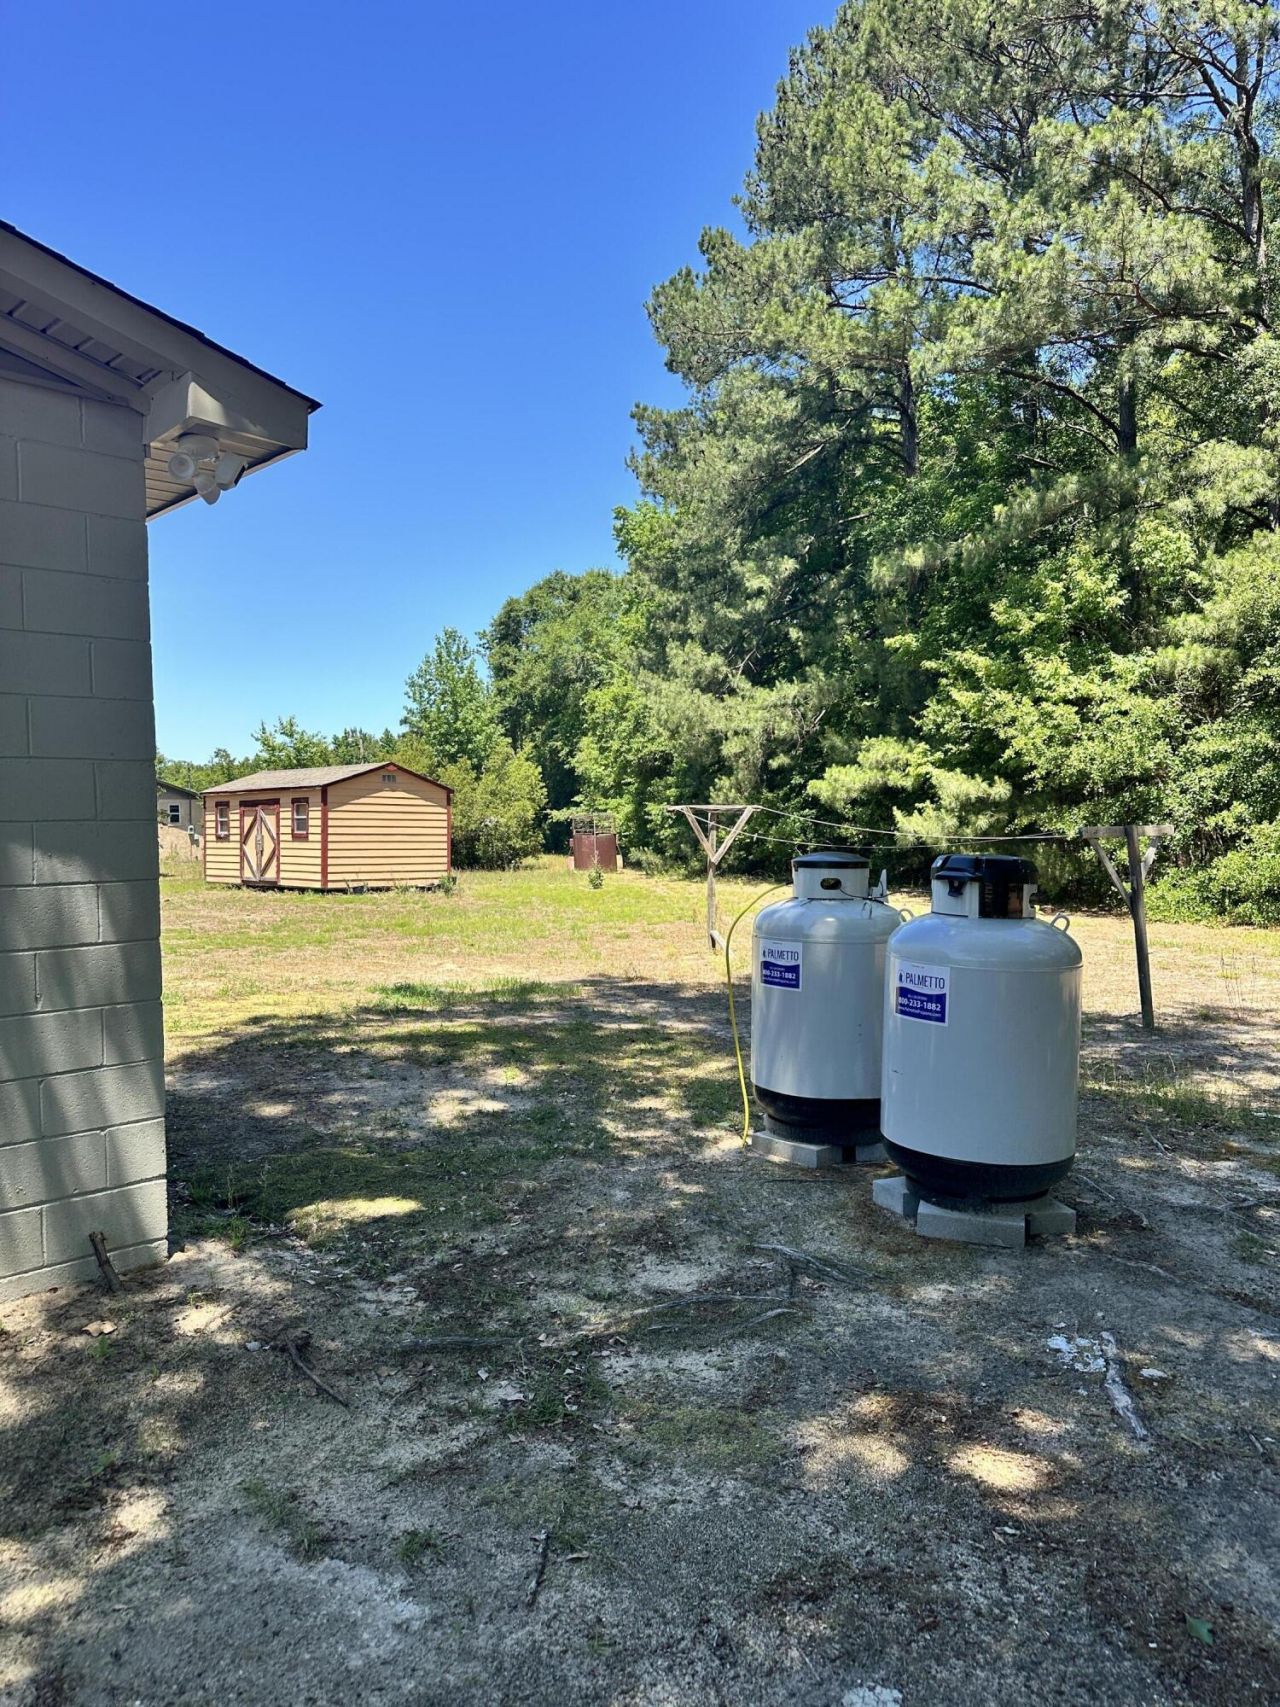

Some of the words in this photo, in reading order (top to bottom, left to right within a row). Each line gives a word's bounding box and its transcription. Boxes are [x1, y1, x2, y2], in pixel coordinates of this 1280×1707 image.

[767, 948, 799, 961] PALMETTO
[905, 972, 945, 989] PALMETTO
[898, 996, 941, 1011] 800-233-1882
